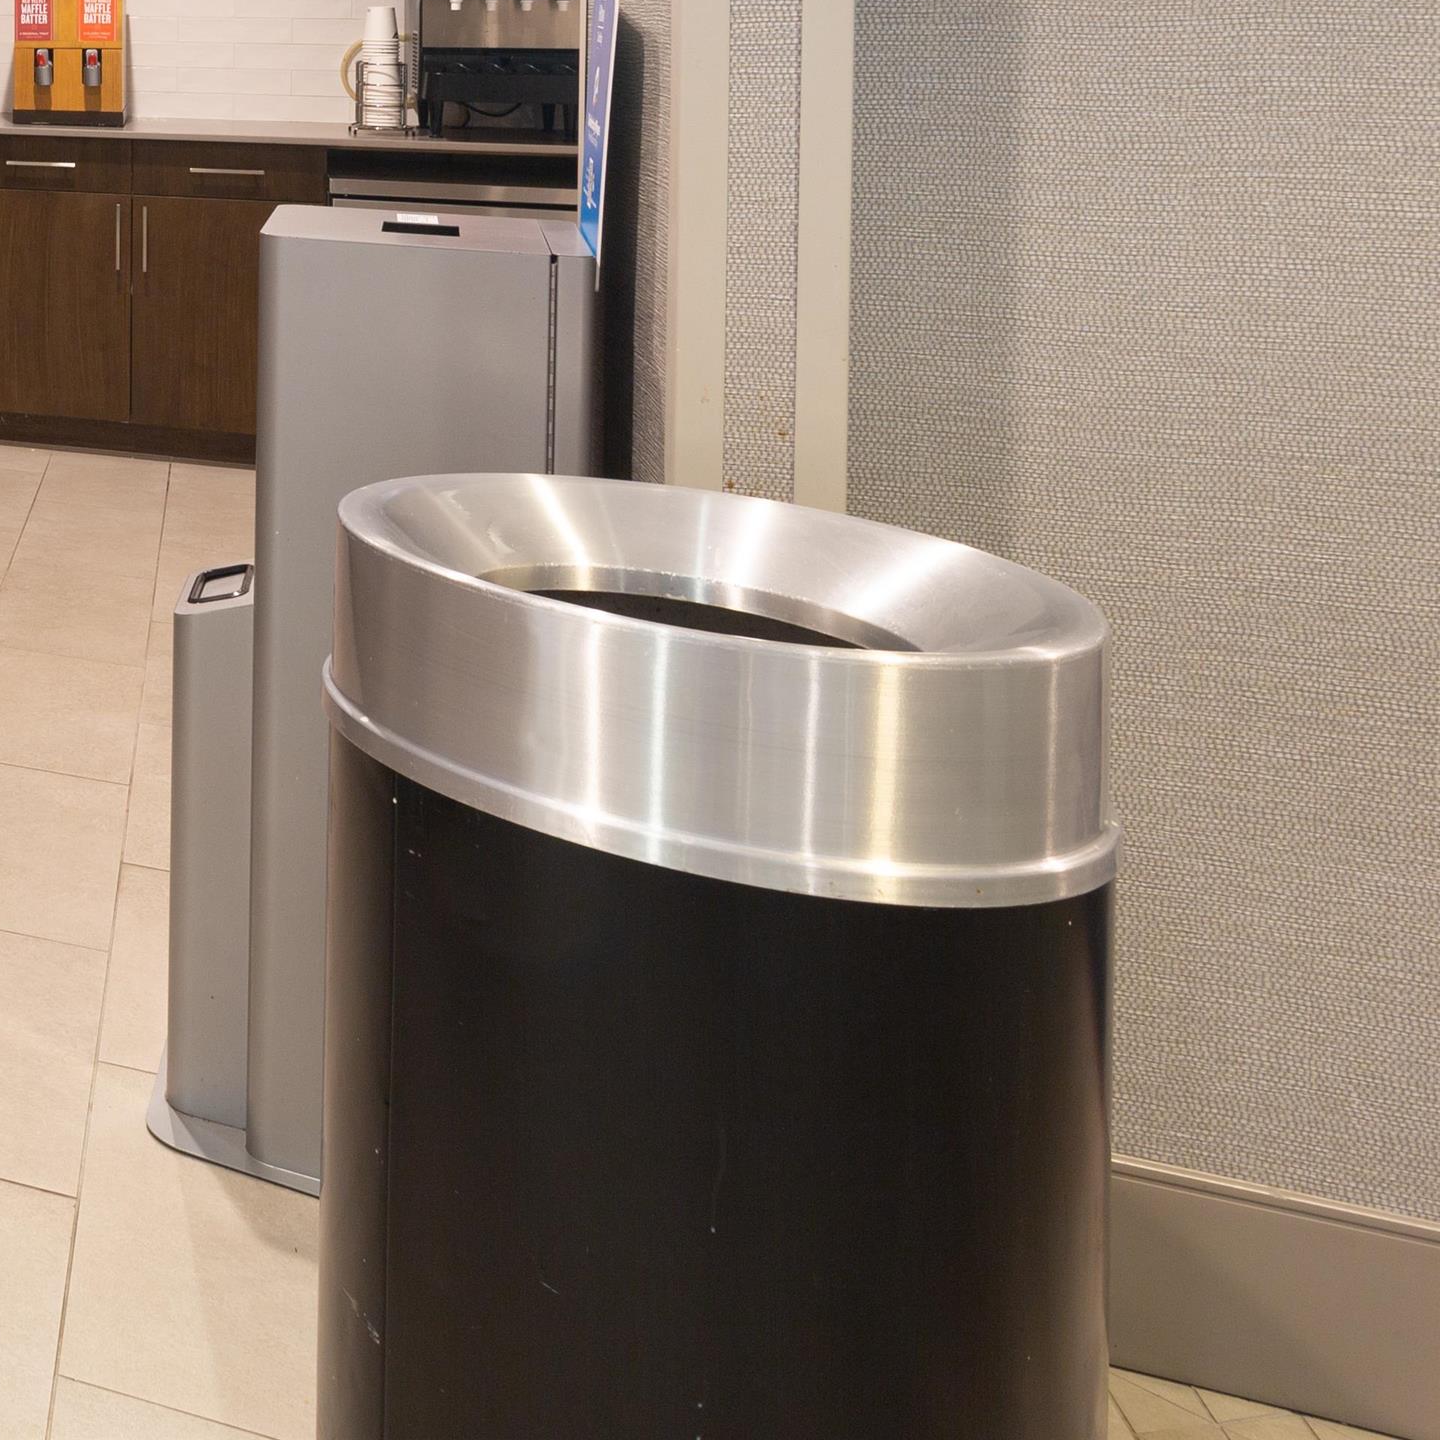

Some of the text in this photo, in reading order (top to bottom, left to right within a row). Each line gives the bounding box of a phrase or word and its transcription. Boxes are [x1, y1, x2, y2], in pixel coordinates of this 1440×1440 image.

[21, 3, 48, 13] WAFFLE
[84, 3, 111, 13] WAFFLE
[21, 14, 48, 24] BATTER
[84, 14, 111, 24] BATTER
